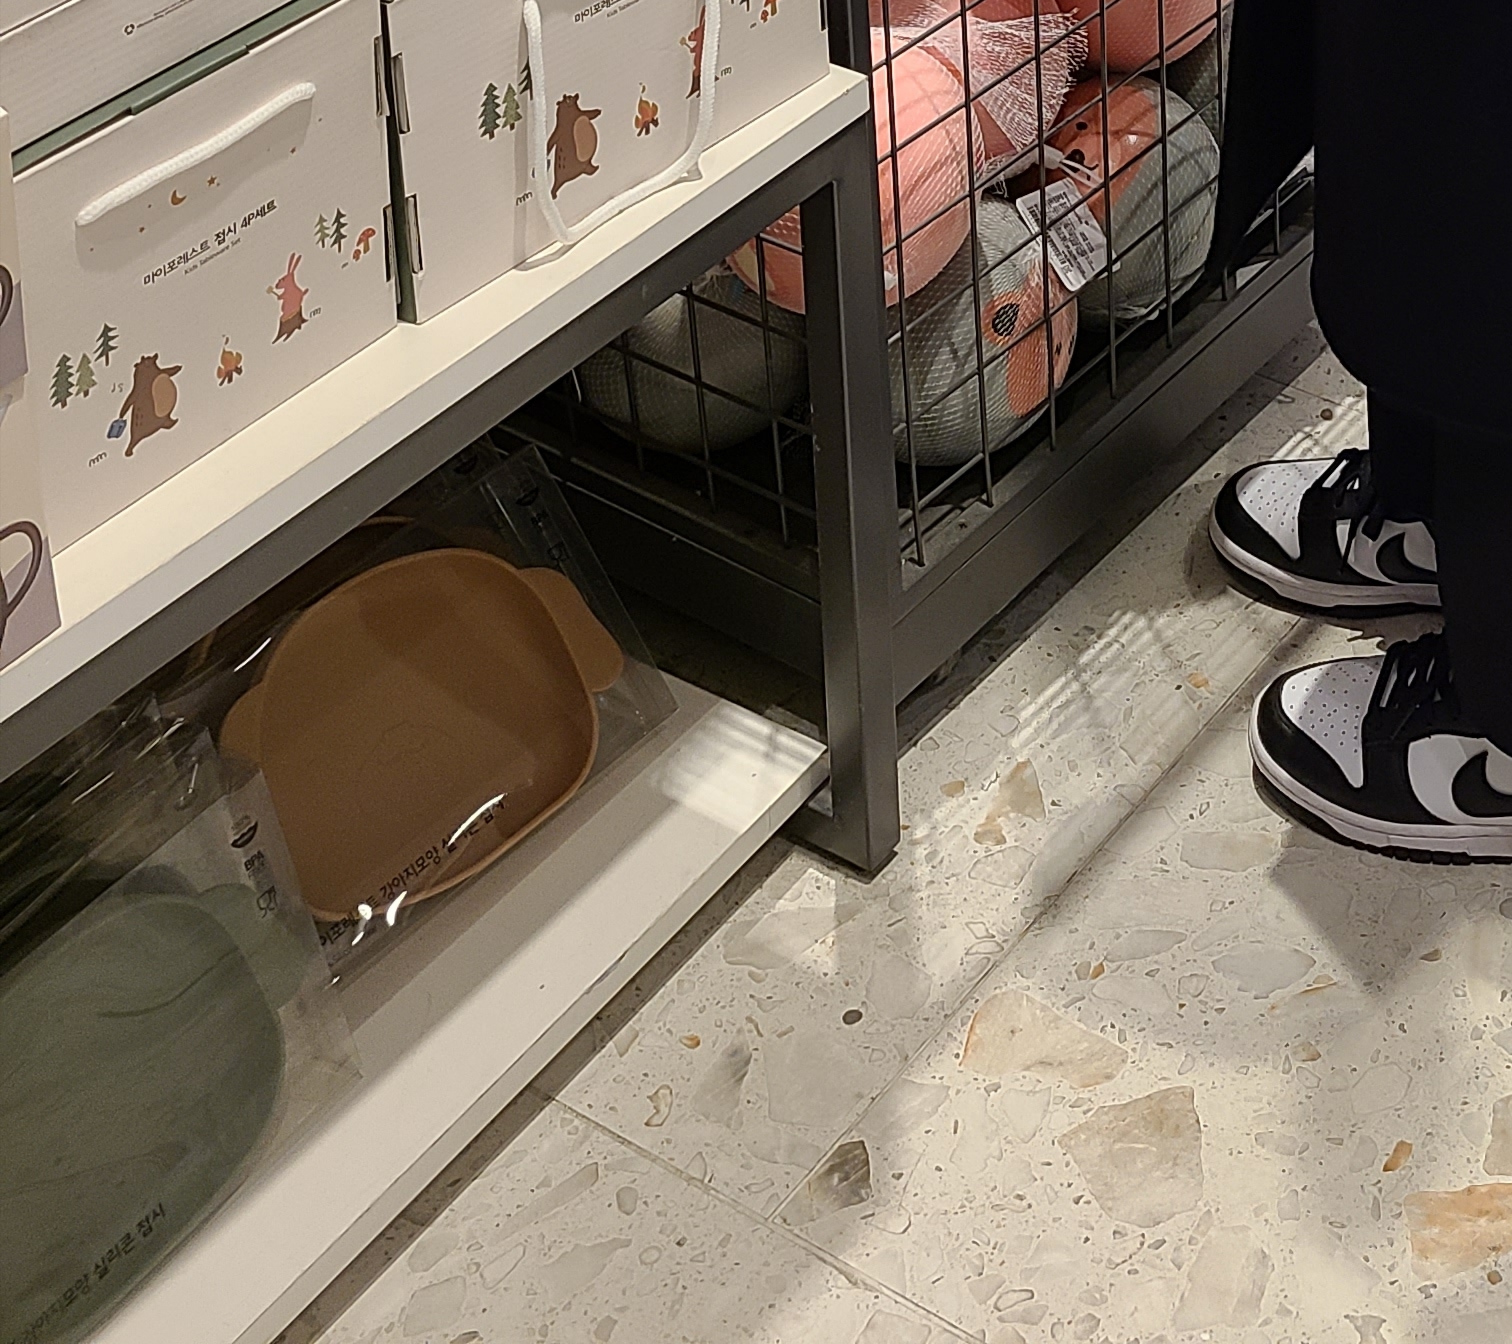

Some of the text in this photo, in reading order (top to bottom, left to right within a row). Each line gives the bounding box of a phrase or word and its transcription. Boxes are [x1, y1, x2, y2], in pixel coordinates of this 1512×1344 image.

[143, 199, 277, 285] 마이포레스트 접시 4P세트
[380, 845, 442, 900] 강아지모양
[93, 1232, 137, 1280] 실리콘
[136, 1202, 166, 1238] 접시
